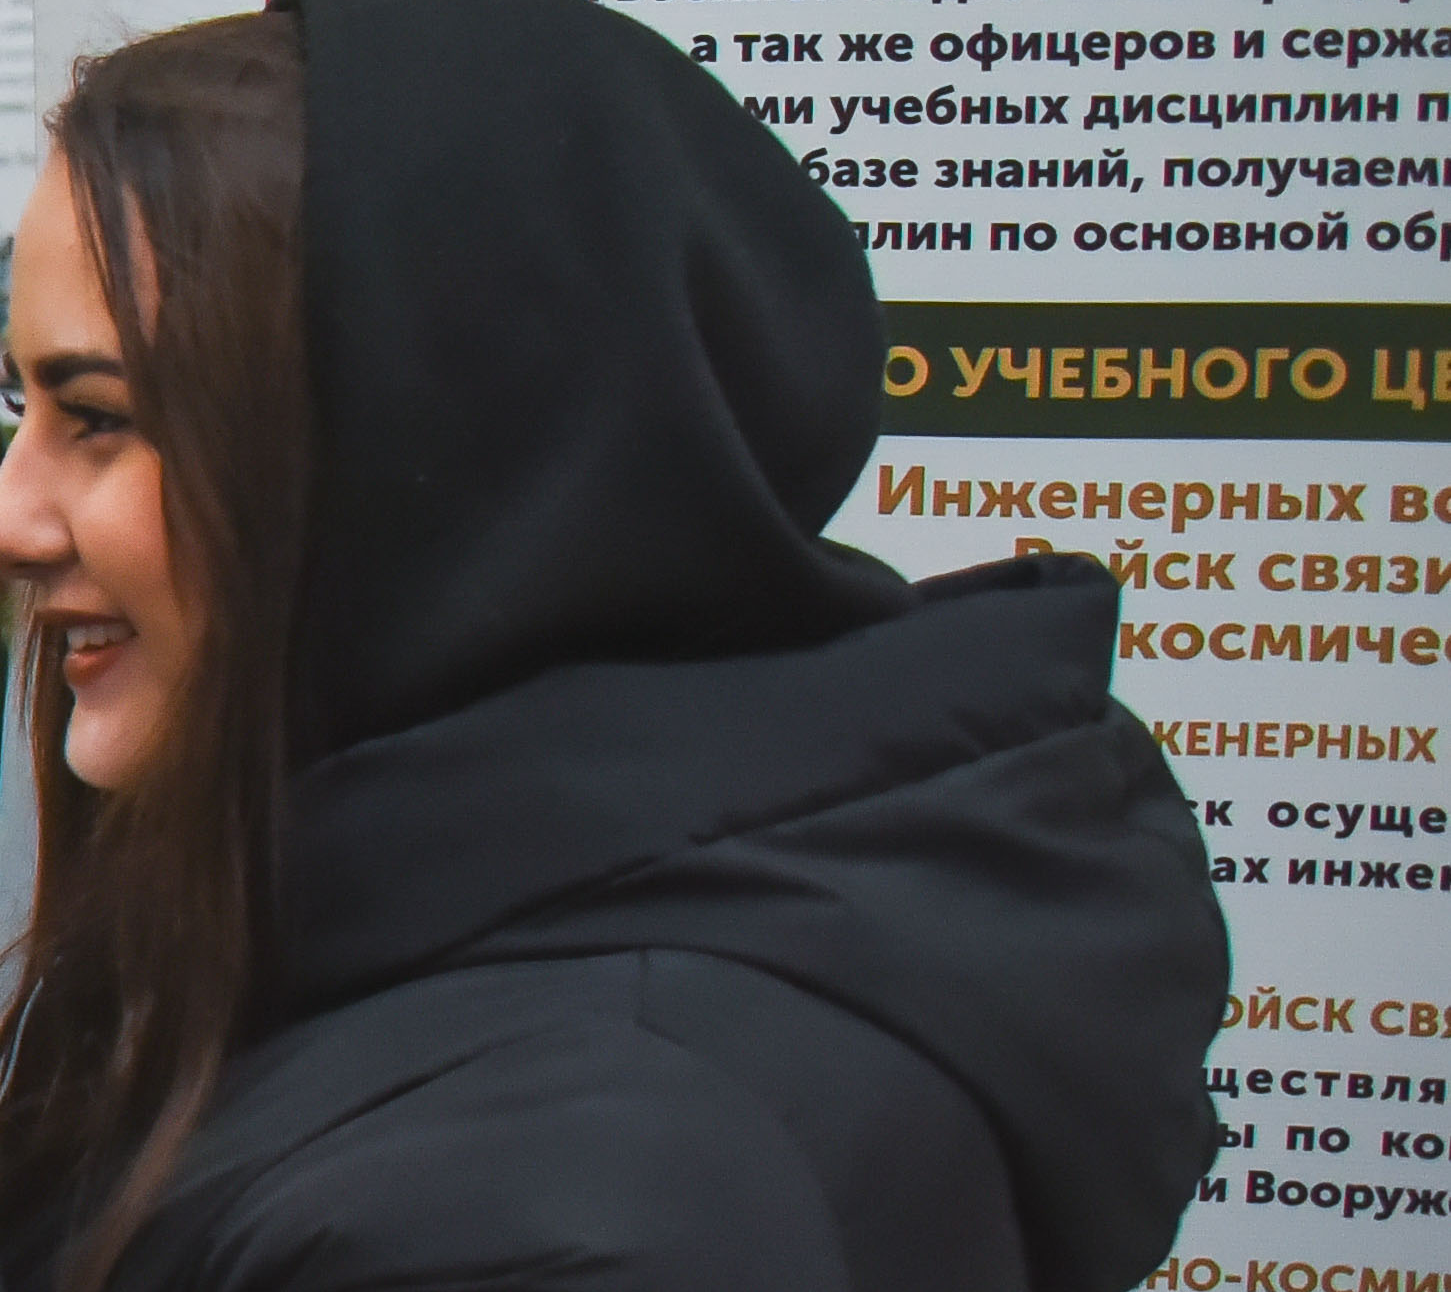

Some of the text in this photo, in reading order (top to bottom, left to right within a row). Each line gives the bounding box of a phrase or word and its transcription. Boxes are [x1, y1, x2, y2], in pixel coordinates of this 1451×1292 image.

[689, 33, 718, 63] а
[733, 33, 825, 62] так
[838, 32, 914, 63] же
[929, 21, 1217, 72] офицеров
[1233, 30, 1265, 60] и
[829, 84, 1070, 134] учебных
[1083, 89, 1399, 130] дисциплин
[800, 147, 920, 189] базе
[934, 148, 1146, 194] знаний,
[990, 221, 1056, 252] по
[1074, 212, 1348, 252] основной
[883, 346, 929, 398] О
[949, 346, 1348, 400] УЧЕБНОГО
[877, 464, 1367, 534] Инженерных
[1118, 621, 1451, 665] космиче
[1266, 800, 1448, 840] осуще
[1286, 1125, 1350, 1152] по
